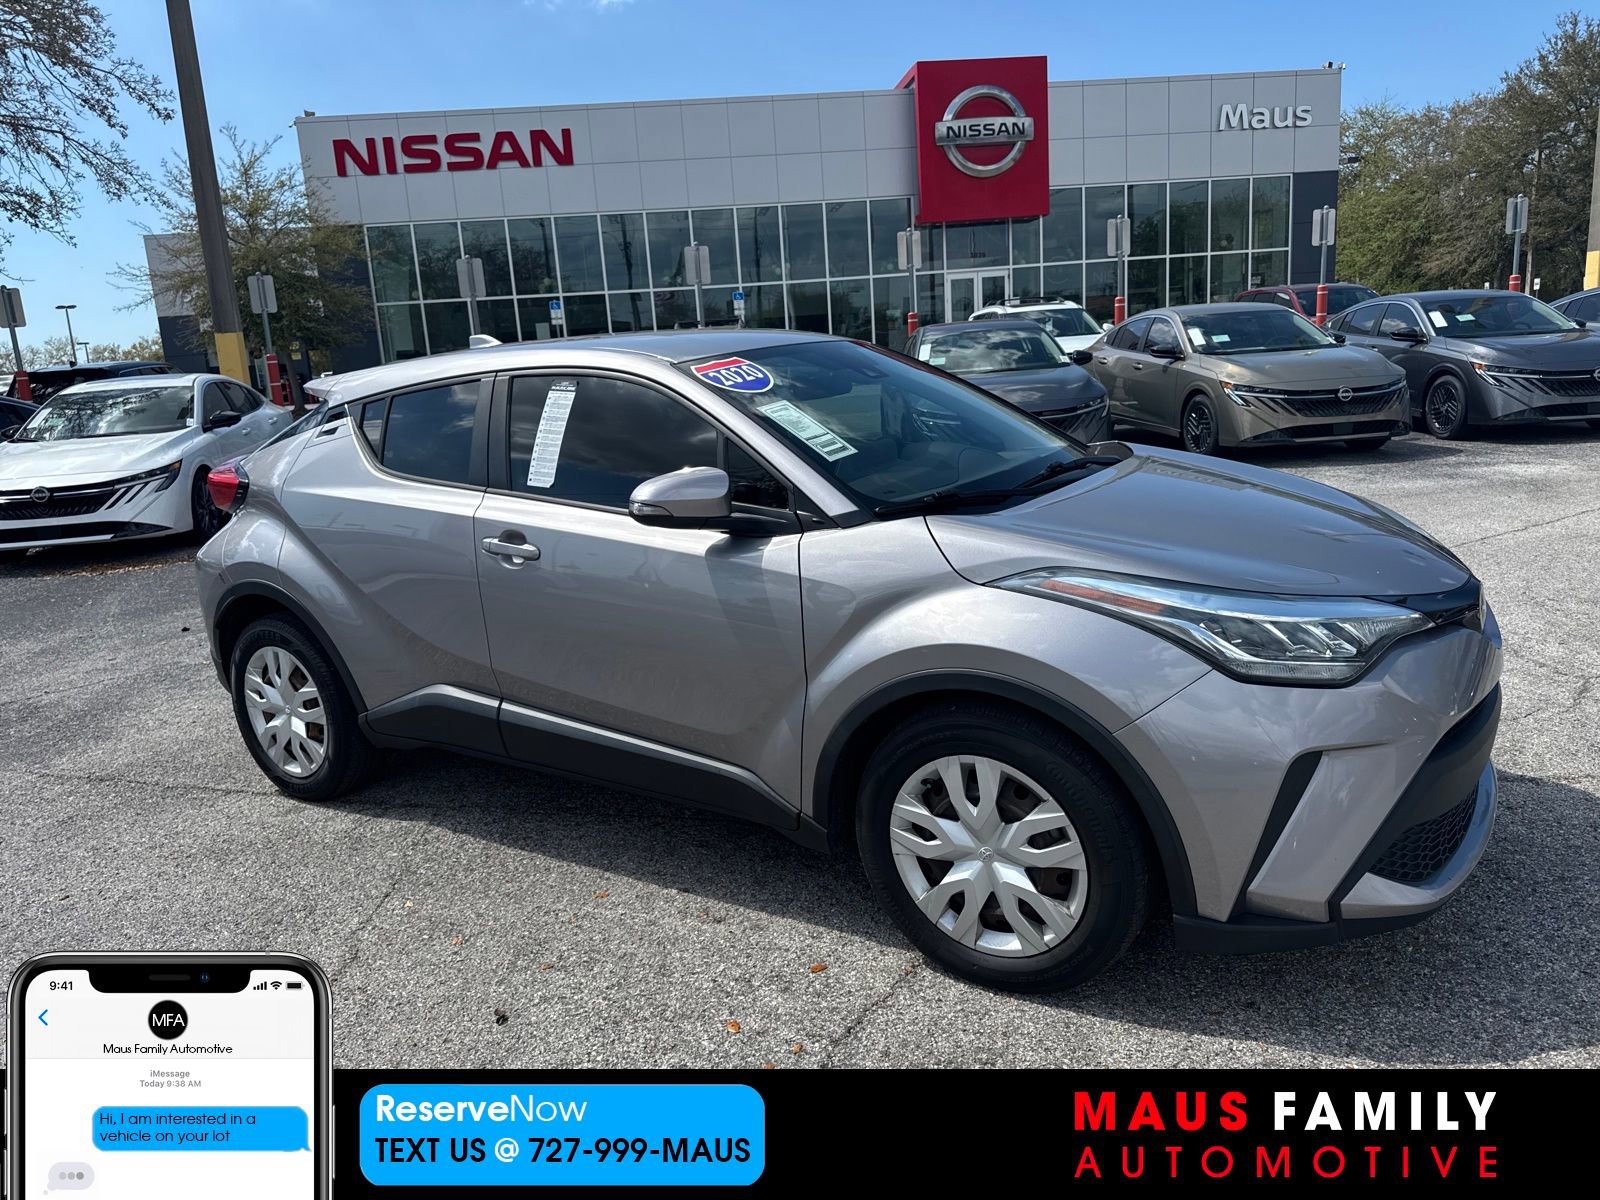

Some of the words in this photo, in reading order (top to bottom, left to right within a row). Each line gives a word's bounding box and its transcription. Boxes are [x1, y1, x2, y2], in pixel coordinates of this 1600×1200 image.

[1219, 103, 1313, 131] Maus
[946, 122, 1026, 139] NISSAN
[333, 128, 574, 177] NISSAN
[708, 365, 764, 386] 2020
